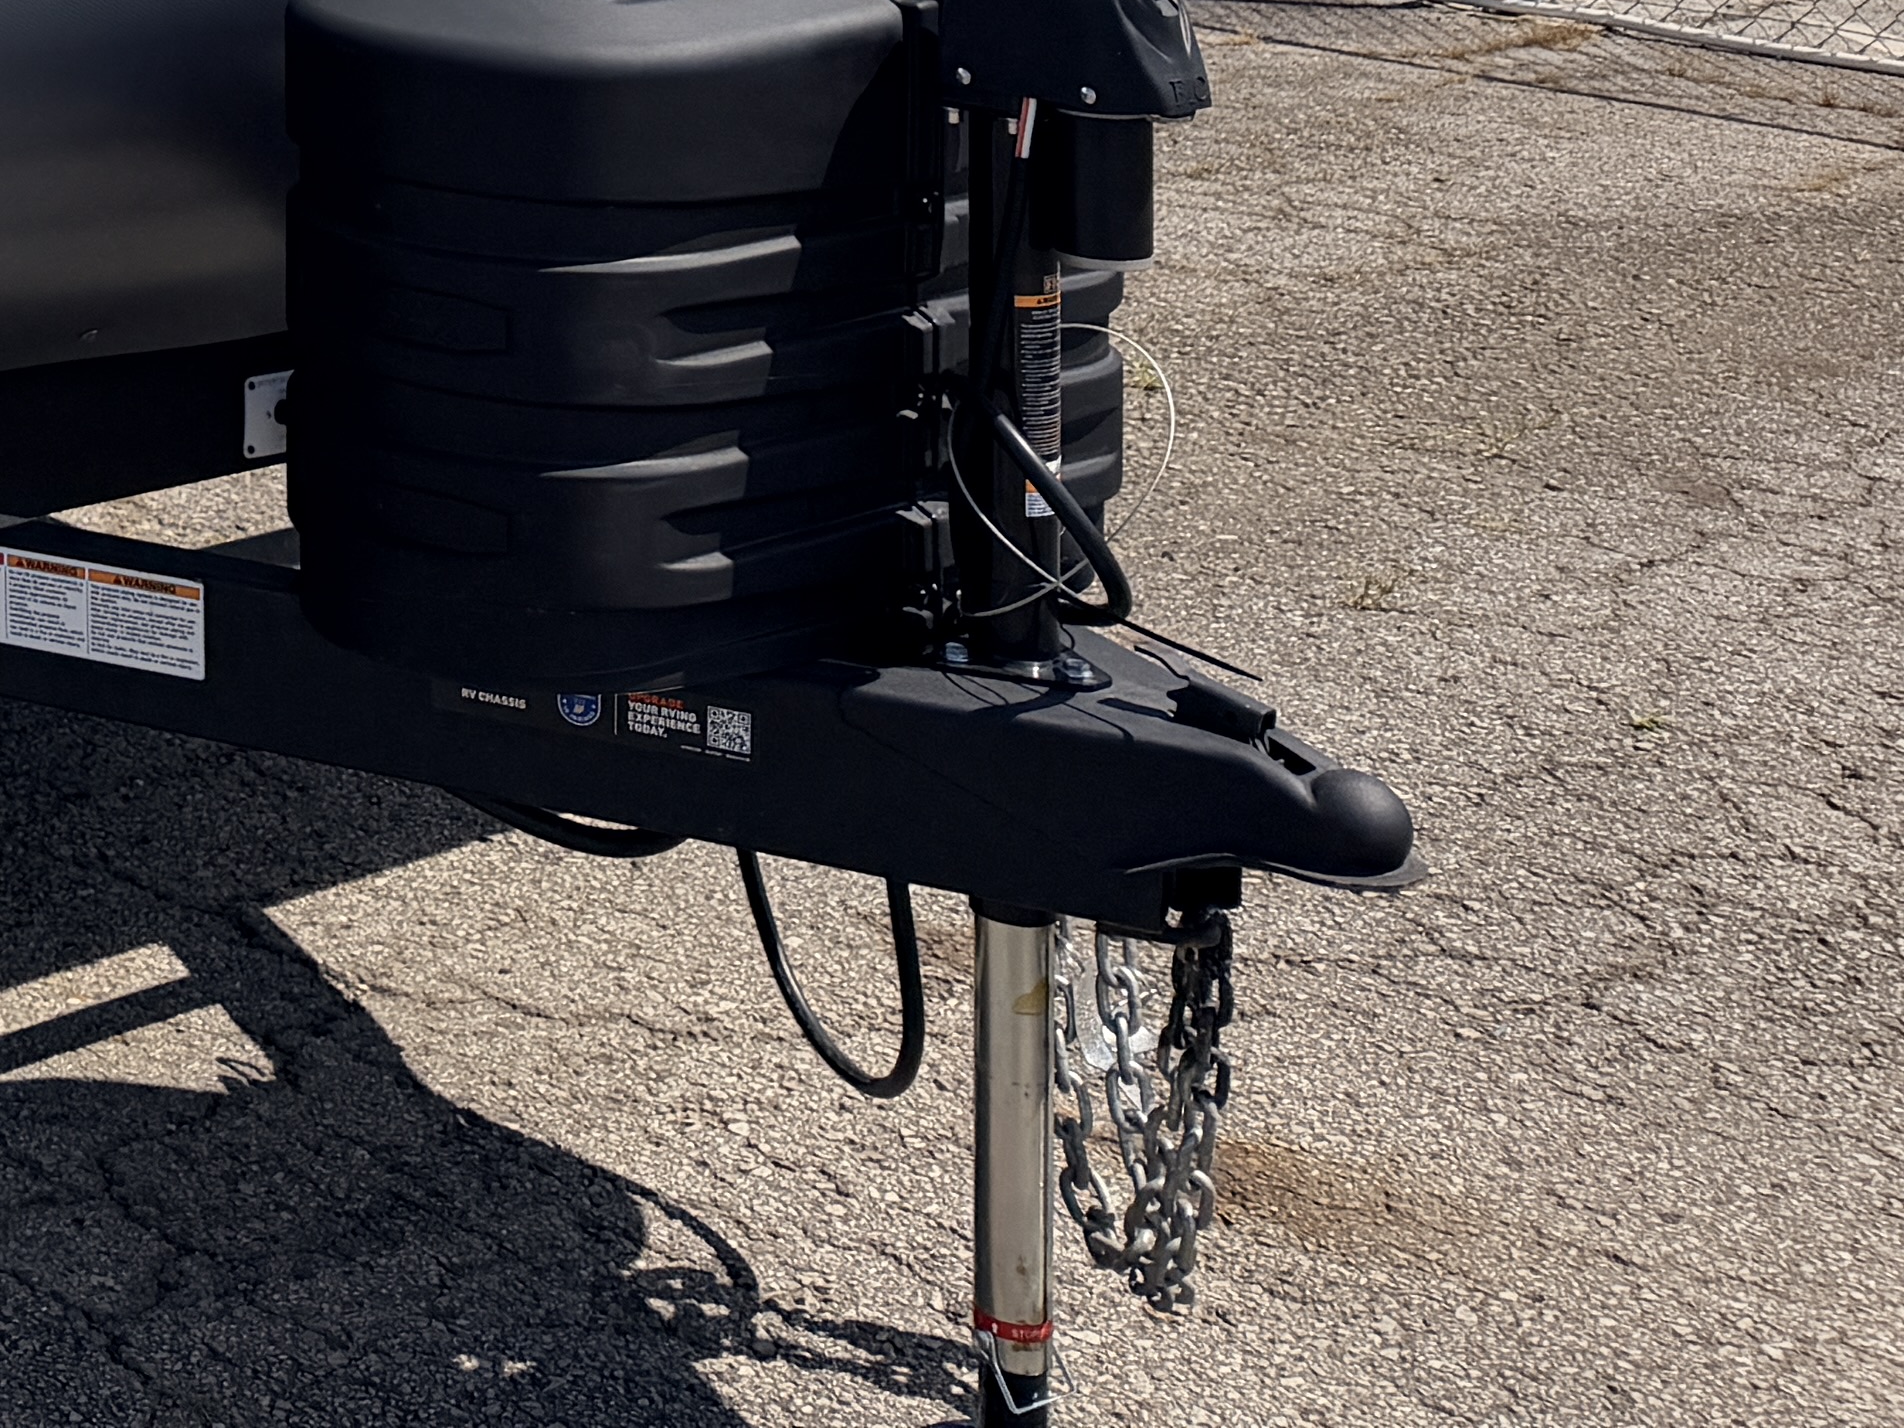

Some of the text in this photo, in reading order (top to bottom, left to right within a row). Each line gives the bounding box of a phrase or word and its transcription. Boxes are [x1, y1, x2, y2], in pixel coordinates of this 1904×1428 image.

[478, 691, 526, 709] CHASSIS
[628, 700, 658, 715] YOUR
[628, 711, 701, 734] EXPERIENCE
